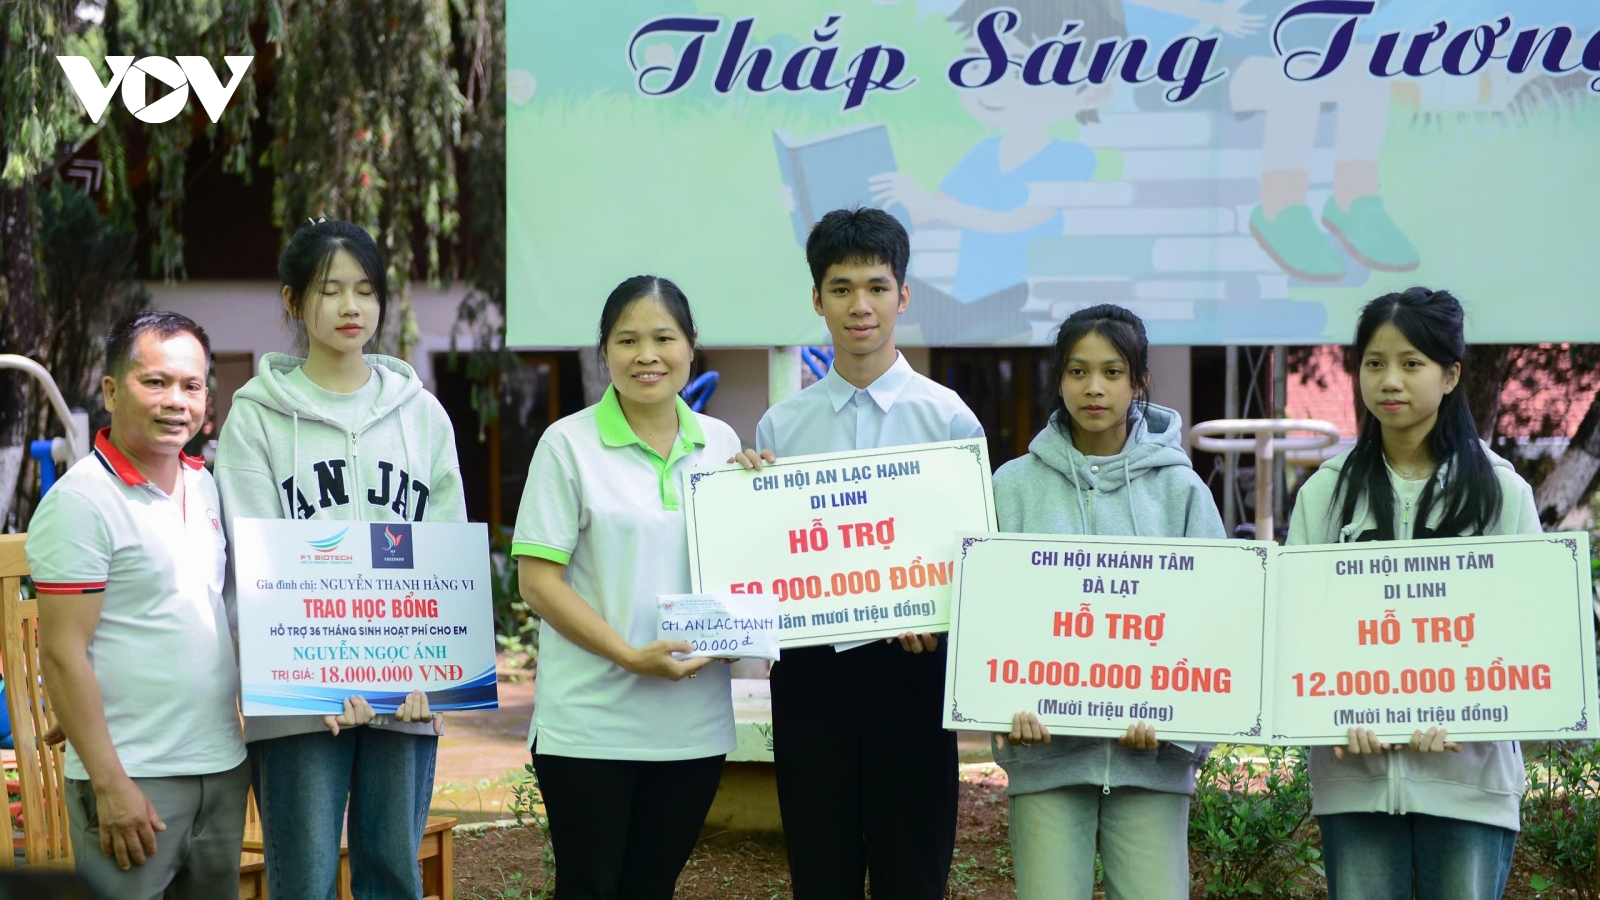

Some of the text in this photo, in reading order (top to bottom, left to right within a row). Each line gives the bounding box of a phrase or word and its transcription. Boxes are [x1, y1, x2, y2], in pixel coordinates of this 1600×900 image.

[629, 15, 916, 111] Thắp
[948, 10, 1225, 103] Sáng
[752, 460, 921, 492] CHI HỘI AN LẠC HẠNH
[810, 490, 868, 510] DI LINH
[788, 517, 895, 554] HỖ TRỢ
[1031, 549, 1195, 571] CHI HỘI KHÁNH TÂM
[1336, 551, 1494, 577] CHI HỘI MINH TÂM
[256, 573, 475, 593] Gia đình chị: NGUYỄN THANH HẰNG VI
[730, 569, 881, 602] 0000.000
[1082, 575, 1140, 598] ĐÀ LẠT
[1384, 582, 1447, 600] DI LINH
[303, 591, 438, 622] TRAO HỌC BỔNG
[812, 608, 849, 626] mươi
[853, 603, 889, 625] triệu
[894, 599, 936, 619] đồng)
[270, 623, 467, 639] HỖ TRỢ 36 THÁNG SINH HOẠT PHÍ CHO EM
[685, 619, 705, 631] AN
[1053, 603, 1166, 647] HỖ TRỢ
[1358, 609, 1475, 648] HỖ TRỢ
[293, 640, 447, 663] NGUYỄN NGỌC ÁNH
[690, 639, 739, 652] 00.000
[271, 664, 463, 683] TRỊ GIÁ: 18.000.000 VNĐ
[986, 658, 1232, 693] 10.000.000 ĐỒNG
[1292, 657, 1552, 697] 12.000.000 ĐỒNG
[1037, 698, 1174, 722] (Mười triệu đồng)
[1333, 702, 1509, 727] (Mười hai triệu đồng)
